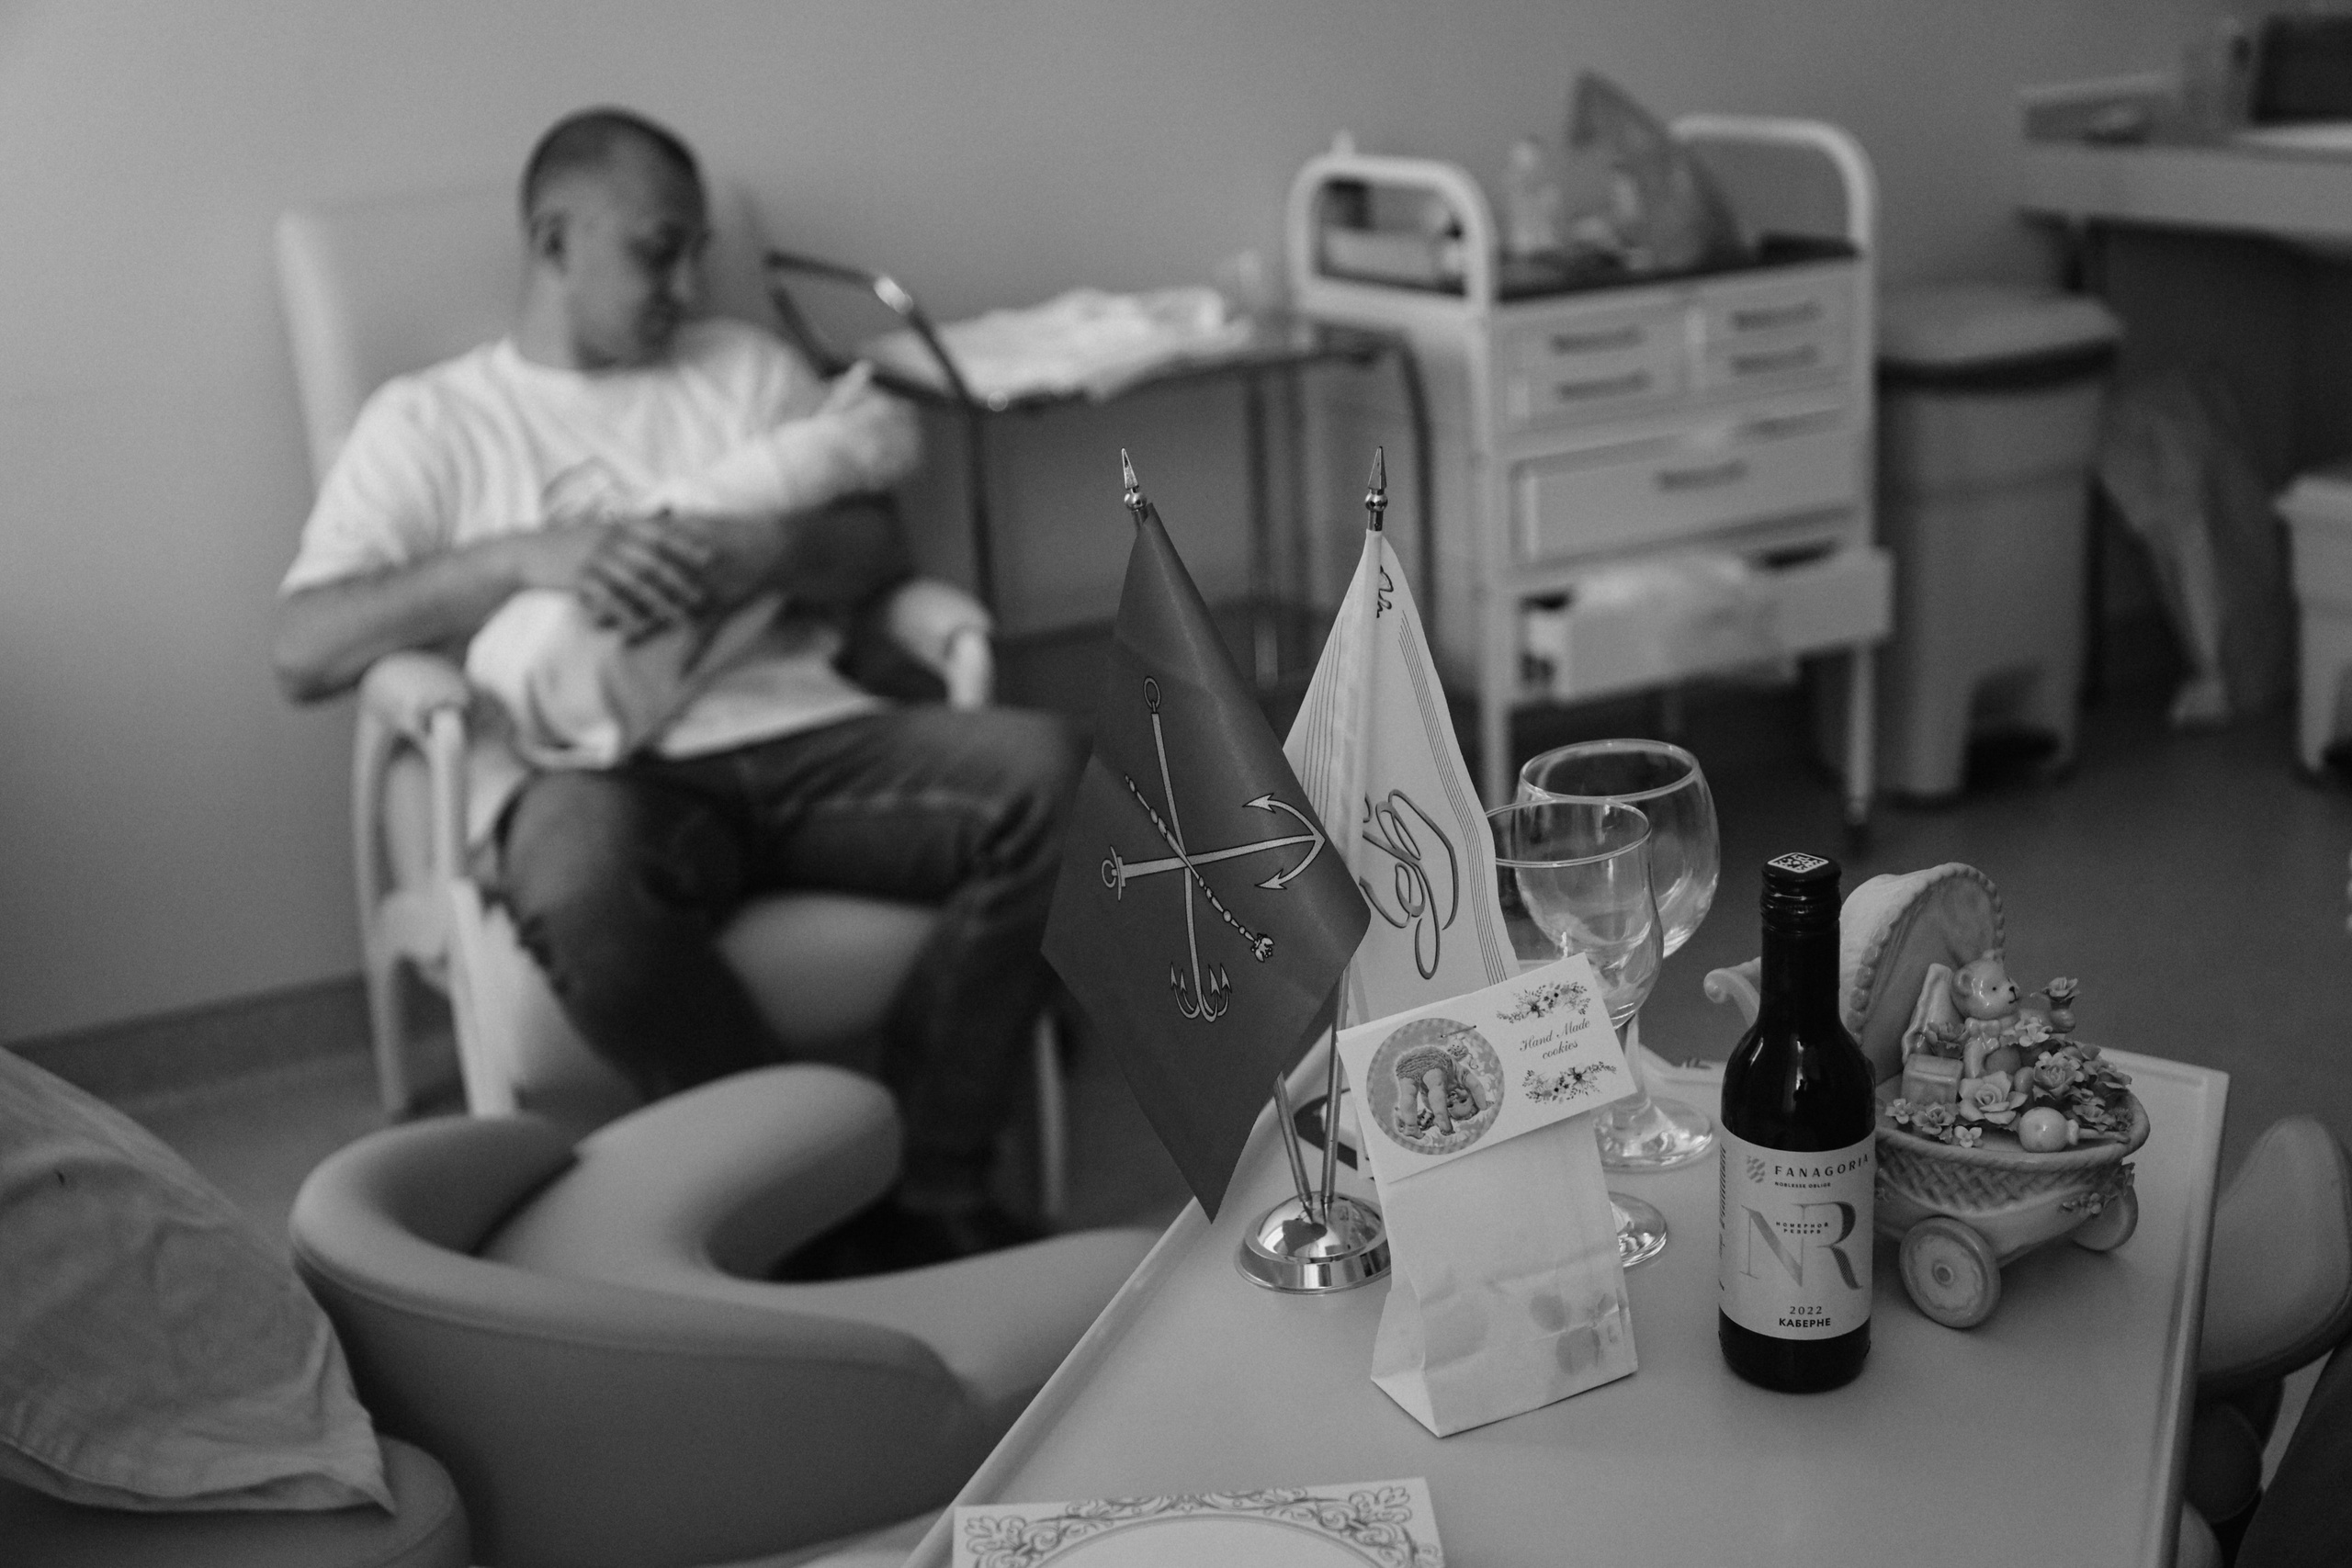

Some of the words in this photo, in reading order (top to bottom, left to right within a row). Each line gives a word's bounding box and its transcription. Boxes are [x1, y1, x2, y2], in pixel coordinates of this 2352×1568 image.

[1520, 1030, 1553, 1052] Hand
[1556, 1018, 1589, 1038] Made
[1542, 1041, 1577, 1059] cookies
[1774, 1154, 1868, 1178] FANAGORIA
[1790, 1305, 1822, 1315] 2022
[1779, 1317, 1831, 1328] КАБЕРНЕ
